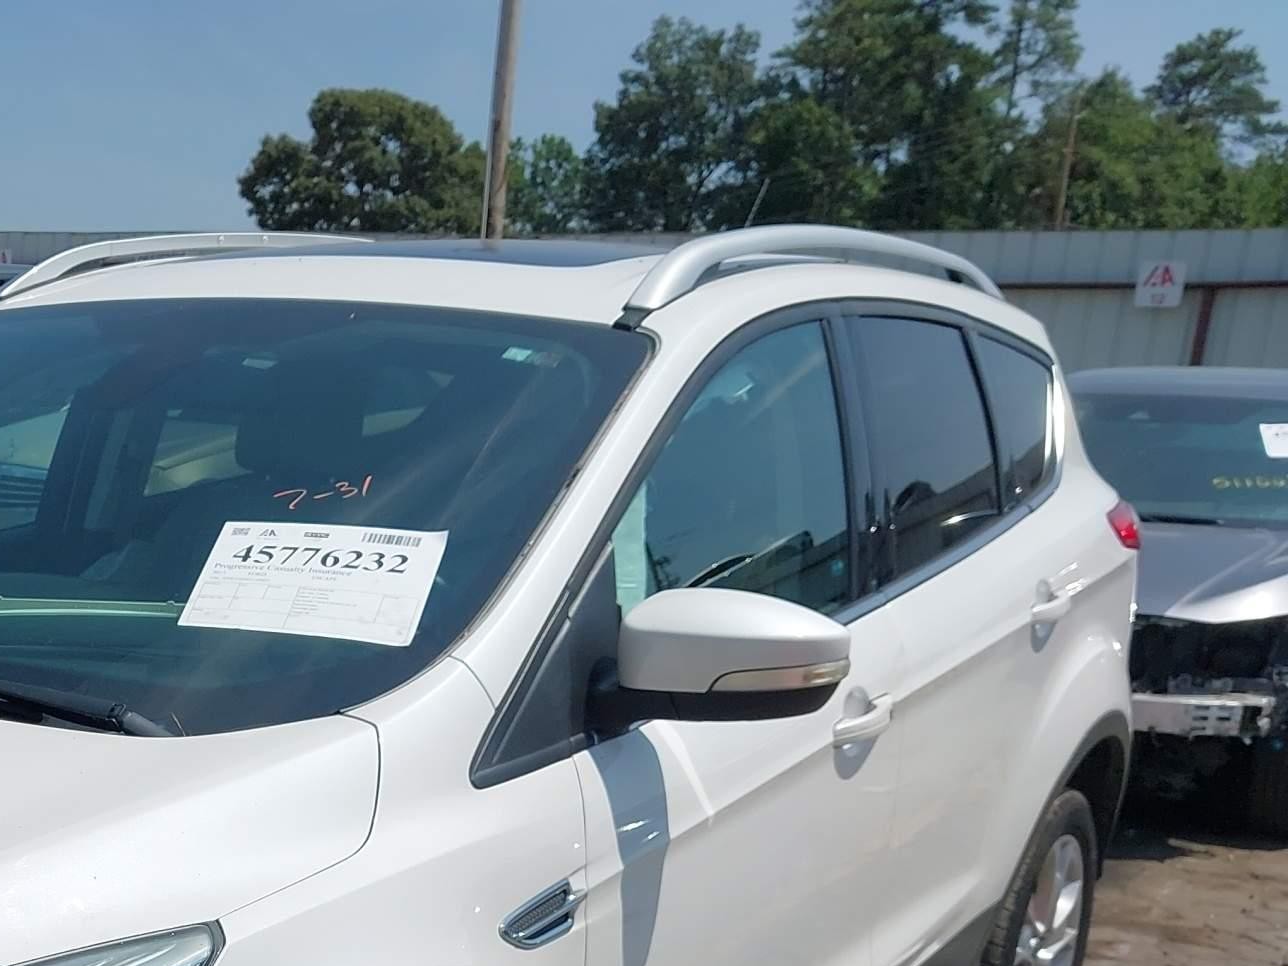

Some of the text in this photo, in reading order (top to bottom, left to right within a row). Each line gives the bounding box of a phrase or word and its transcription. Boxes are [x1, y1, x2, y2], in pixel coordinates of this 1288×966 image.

[272, 474, 373, 510] 7-31
[214, 562, 265, 571] Progressive
[308, 566, 353, 576] Insurance
[232, 544, 409, 574] 45776232
